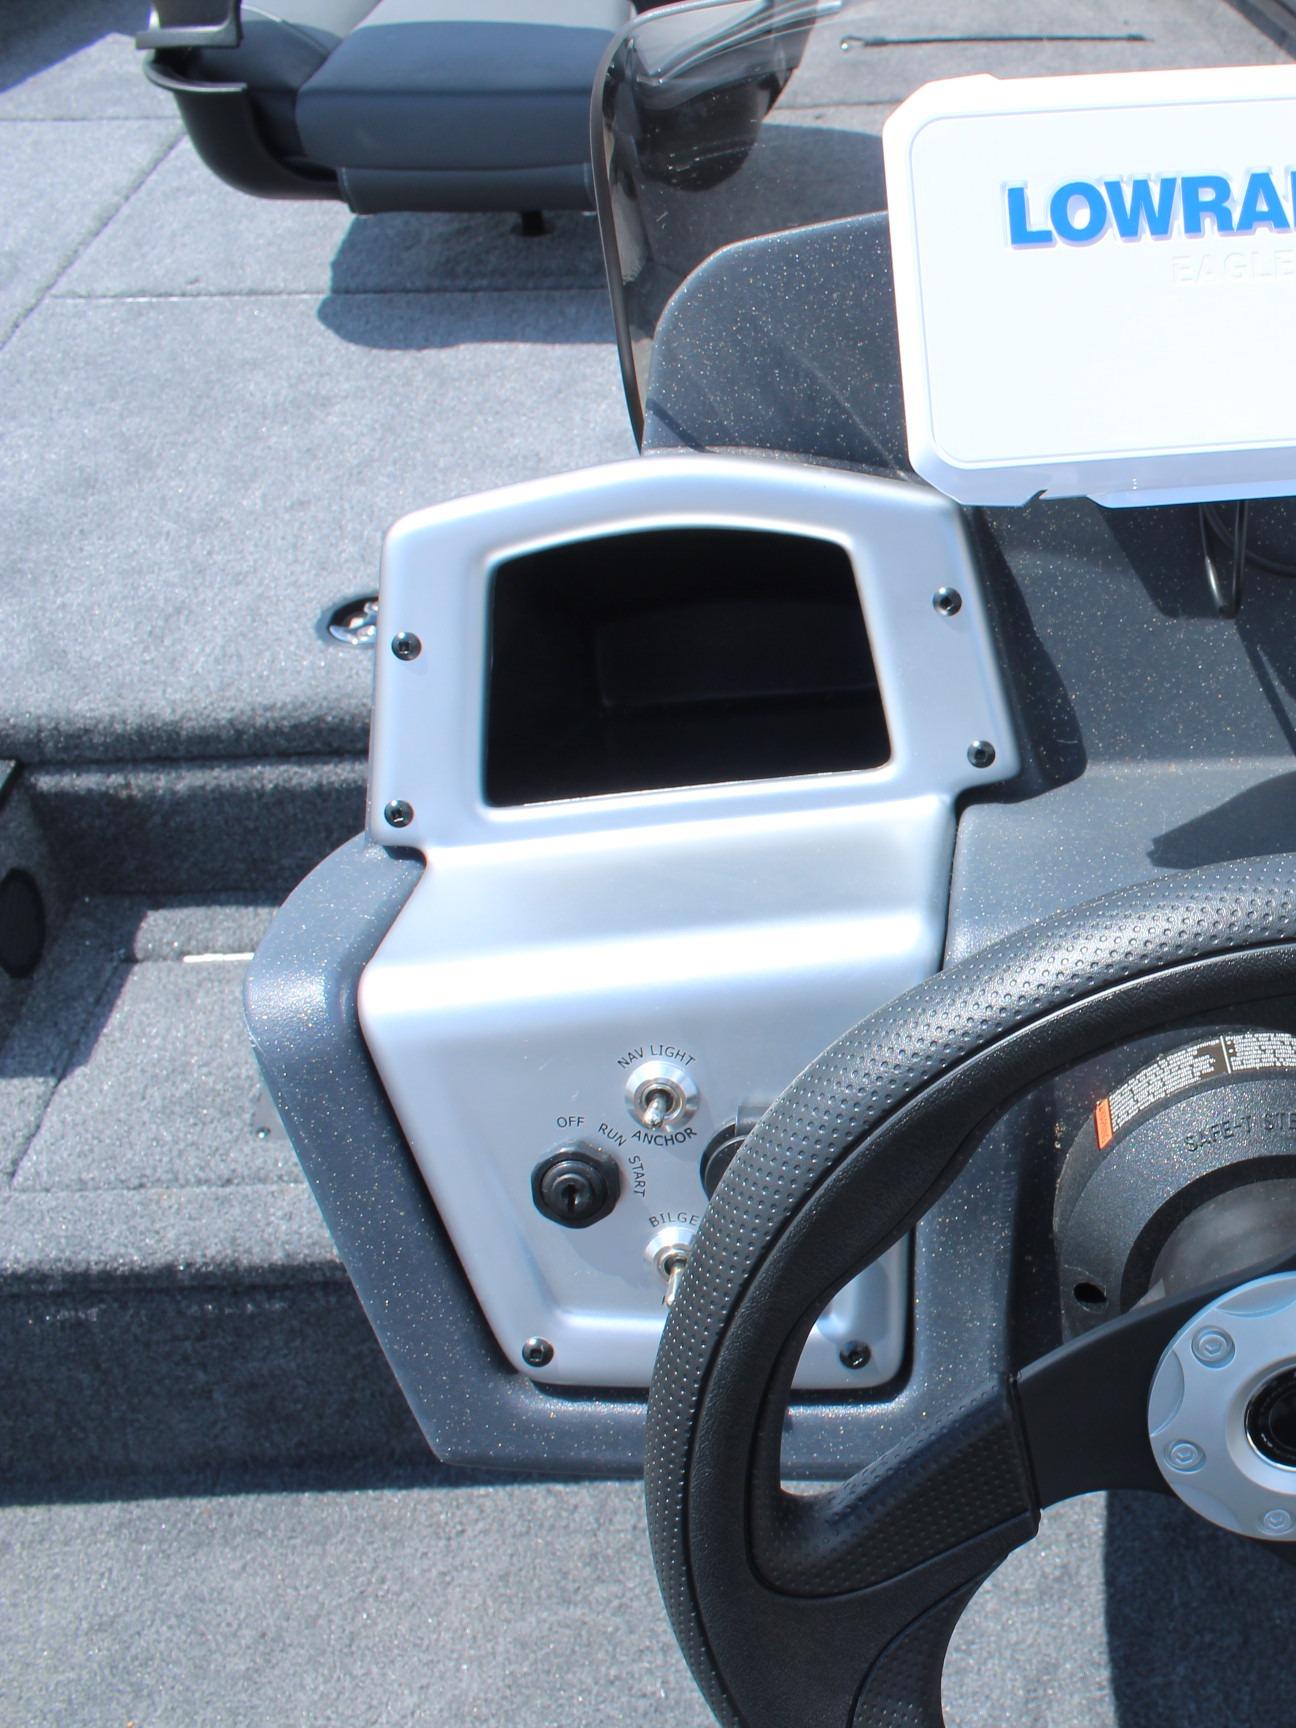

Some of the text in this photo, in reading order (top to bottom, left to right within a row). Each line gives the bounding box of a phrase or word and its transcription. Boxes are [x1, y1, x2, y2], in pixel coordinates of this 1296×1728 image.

[1172, 249, 1295, 282] EAGLE
[617, 1044, 696, 1069] NAV LIGHT
[556, 1115, 585, 1129] OFF
[598, 1122, 627, 1147] RUN
[632, 1126, 697, 1147] ANCHOR
[628, 1155, 646, 1198] START
[648, 1211, 699, 1228] BILGE
